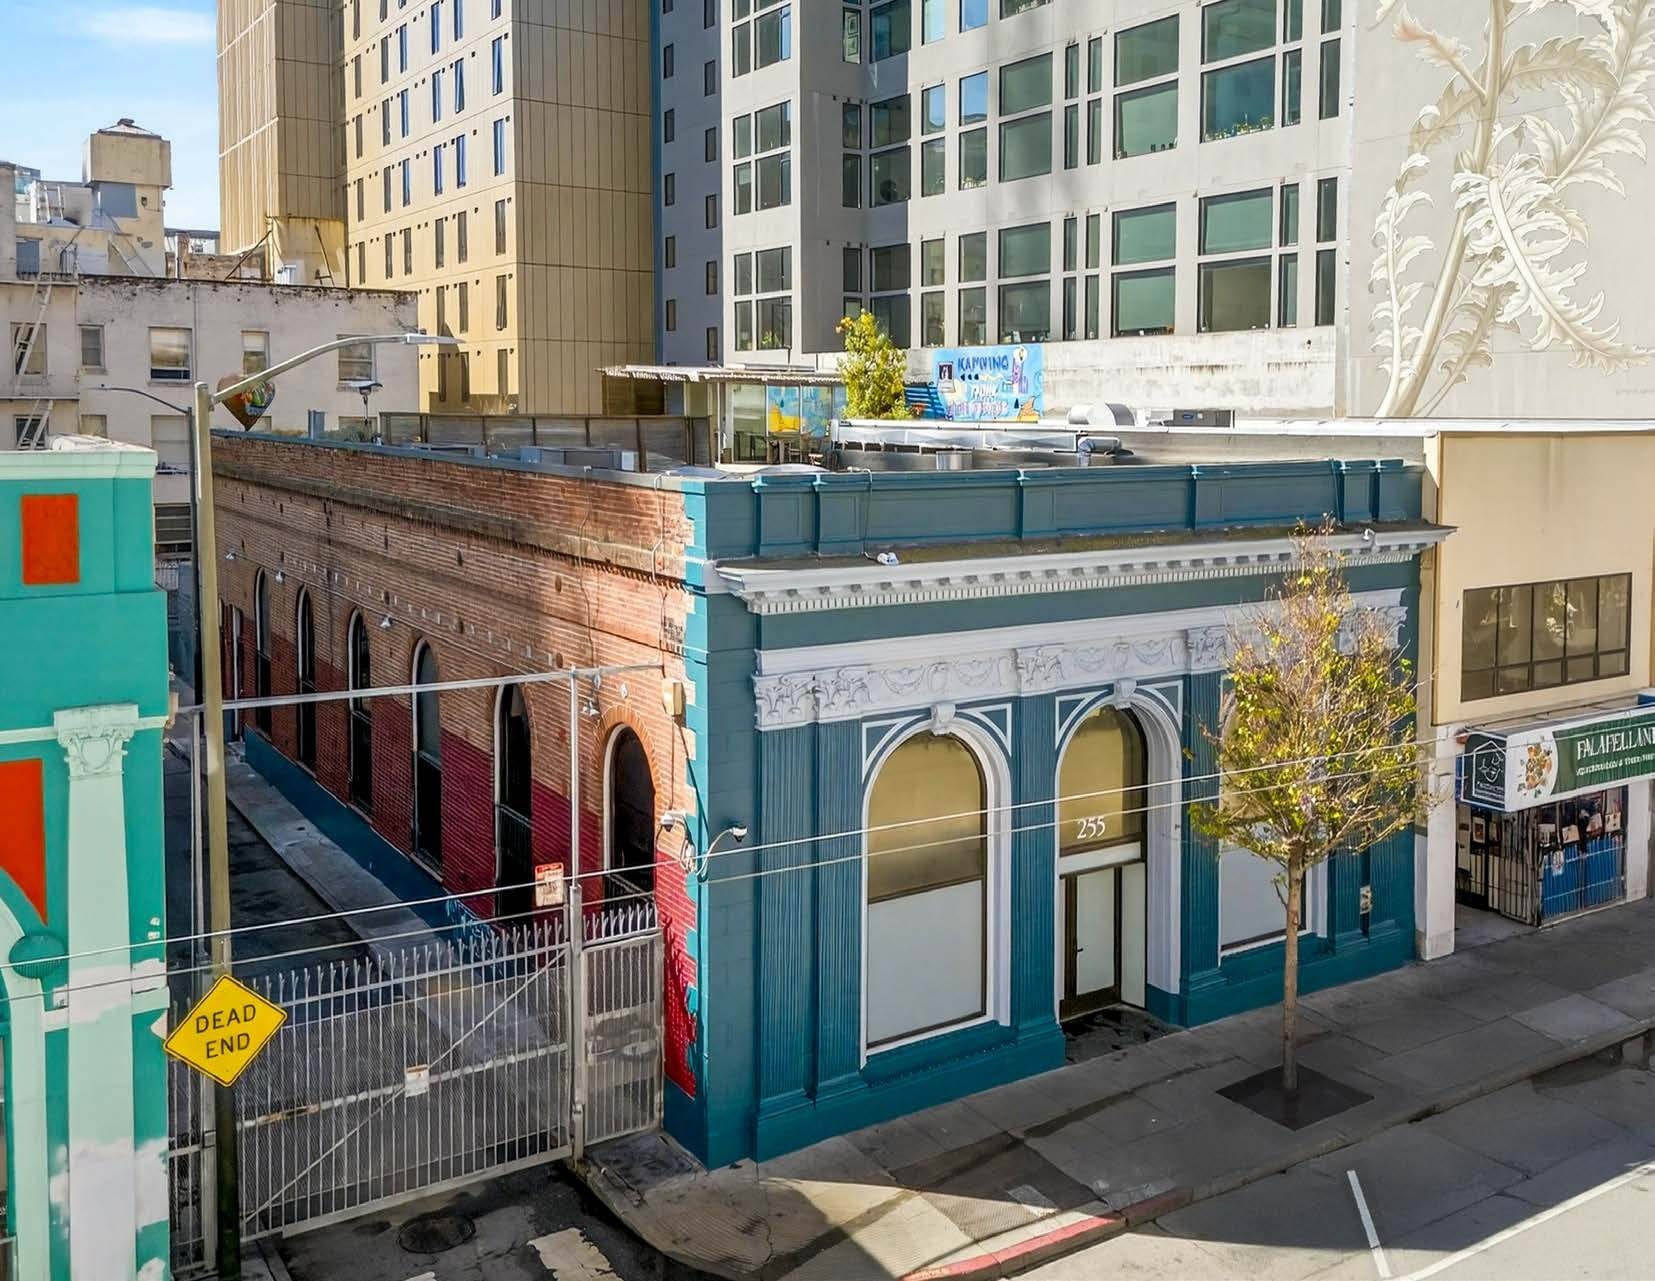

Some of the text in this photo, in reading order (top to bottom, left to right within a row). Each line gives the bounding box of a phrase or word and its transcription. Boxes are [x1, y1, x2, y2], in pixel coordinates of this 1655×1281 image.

[1577, 726, 1655, 761] FALAFELLAN
[1077, 816, 1106, 839] 255
[195, 1004, 256, 1034] DEAD
[206, 1033, 250, 1059] END
